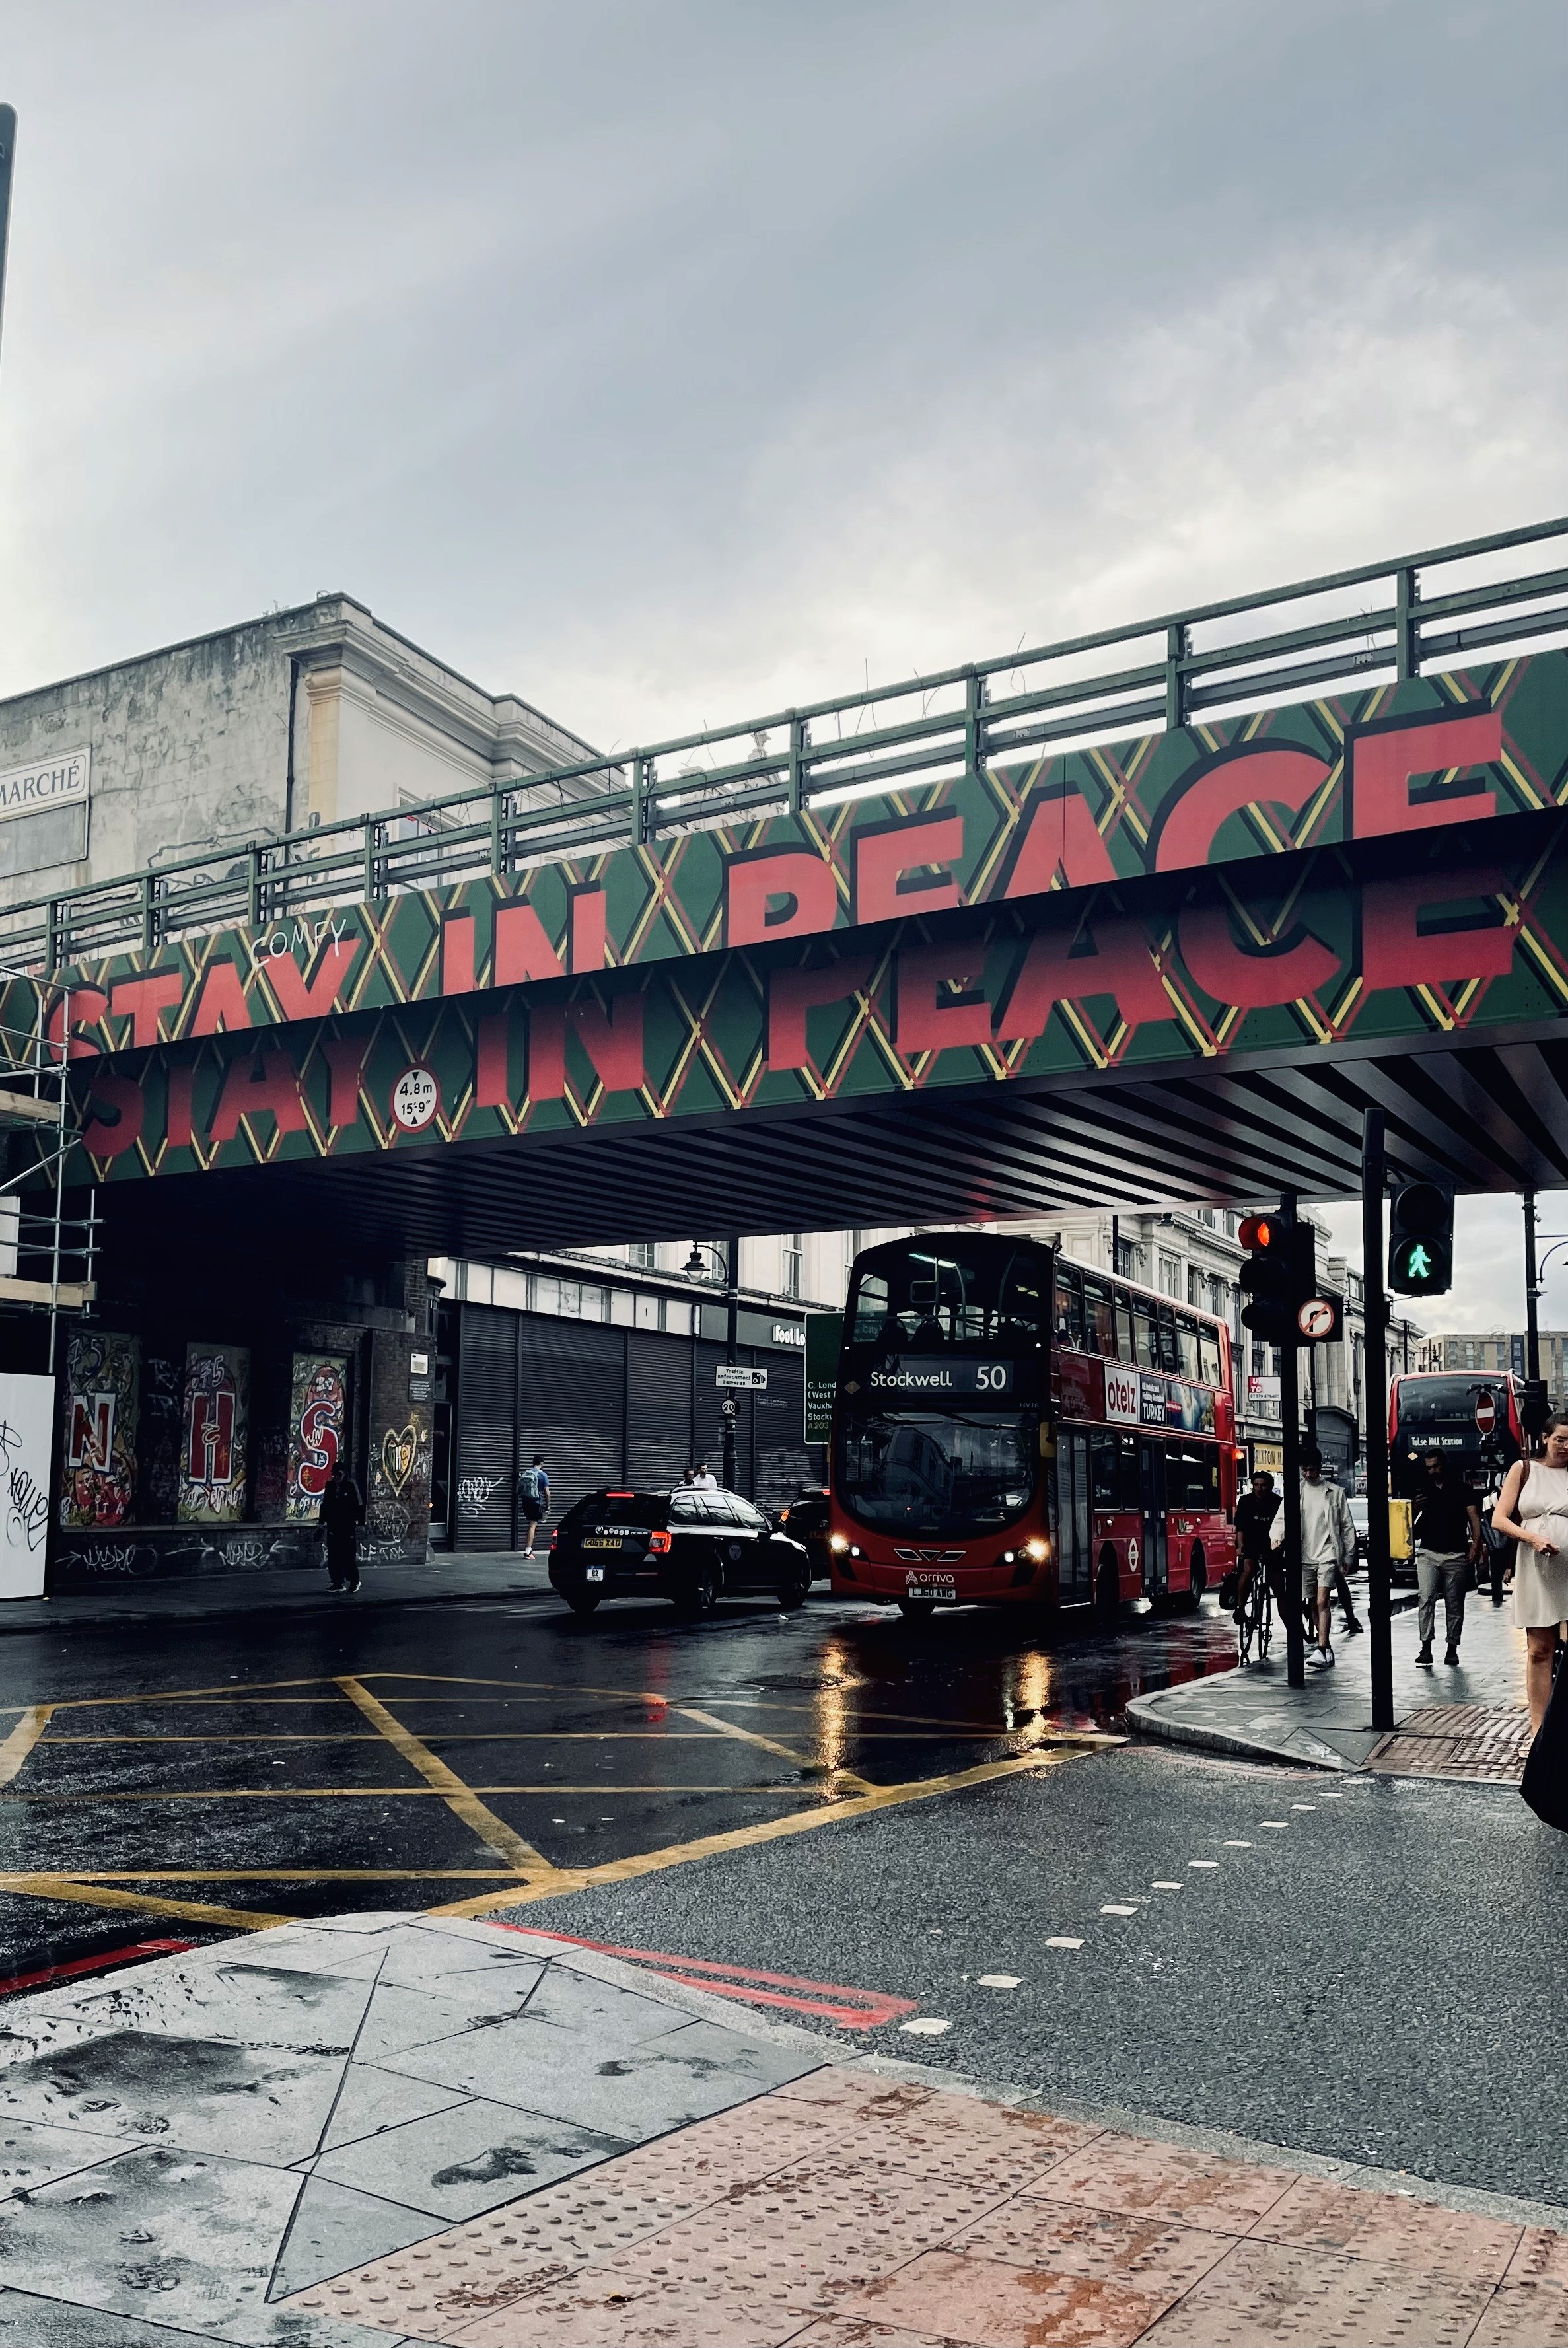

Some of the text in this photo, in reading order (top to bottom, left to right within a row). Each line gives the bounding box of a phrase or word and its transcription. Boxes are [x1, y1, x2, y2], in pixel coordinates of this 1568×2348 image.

[250, 919, 347, 968] COMFY
[400, 1082, 433, 1096] 4.8 m
[870, 1365, 1007, 1390] Stockwell 50
[808, 1390, 831, 1399] (West
[1108, 1376, 1136, 1414] otelz
[1142, 1402, 1165, 1421] TURKEY
[1411, 1436, 1463, 1446] Tulse Hill Station
[919, 1572, 954, 1583] arriva
